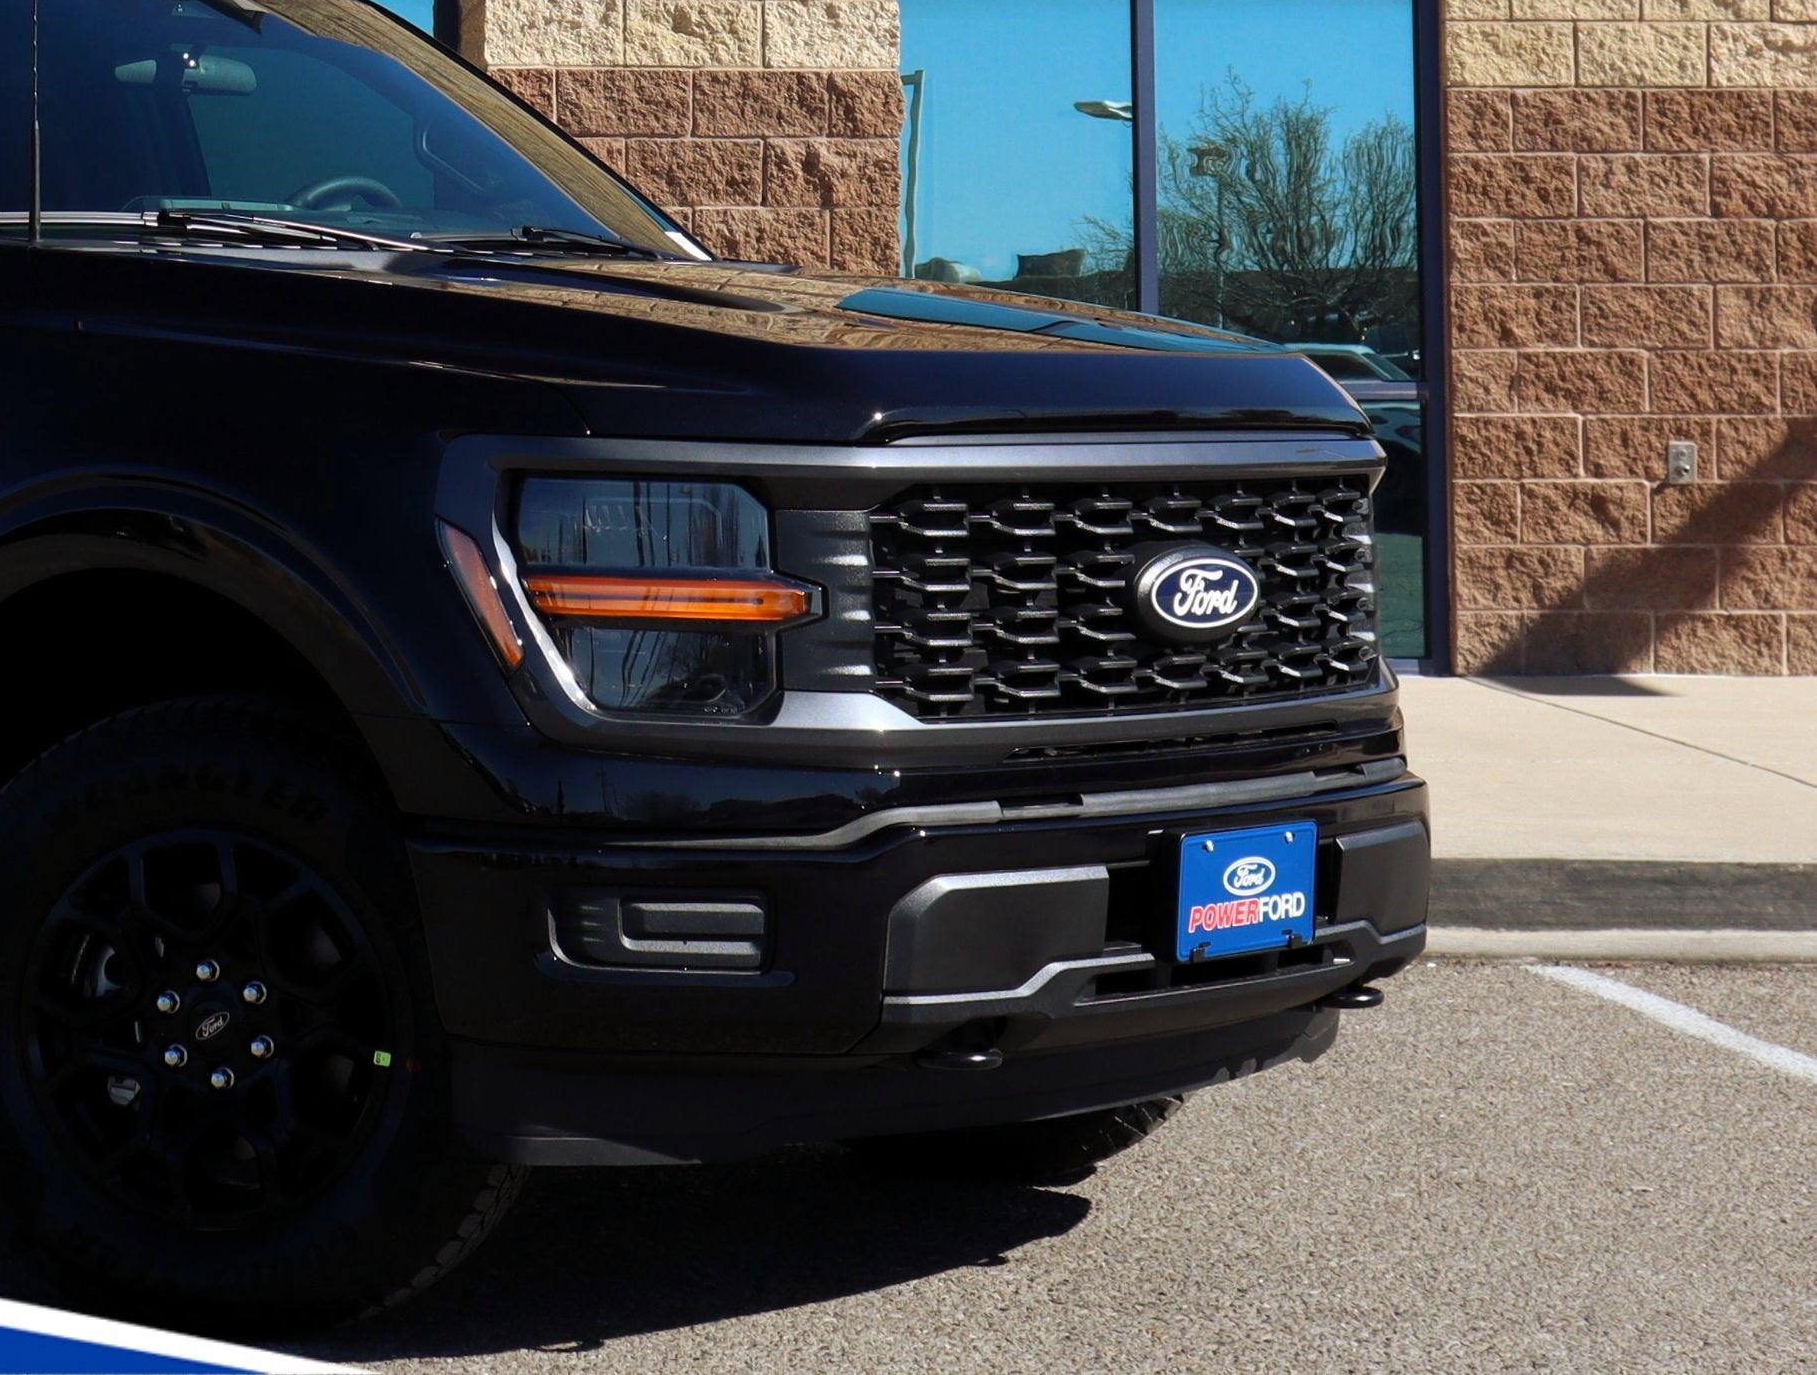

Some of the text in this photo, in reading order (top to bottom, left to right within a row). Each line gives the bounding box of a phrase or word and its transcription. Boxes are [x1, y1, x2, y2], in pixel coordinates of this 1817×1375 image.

[1173, 568, 1239, 616] Ford
[1233, 863, 1265, 888] Ford
[1188, 891, 1306, 933] POWERFORD
